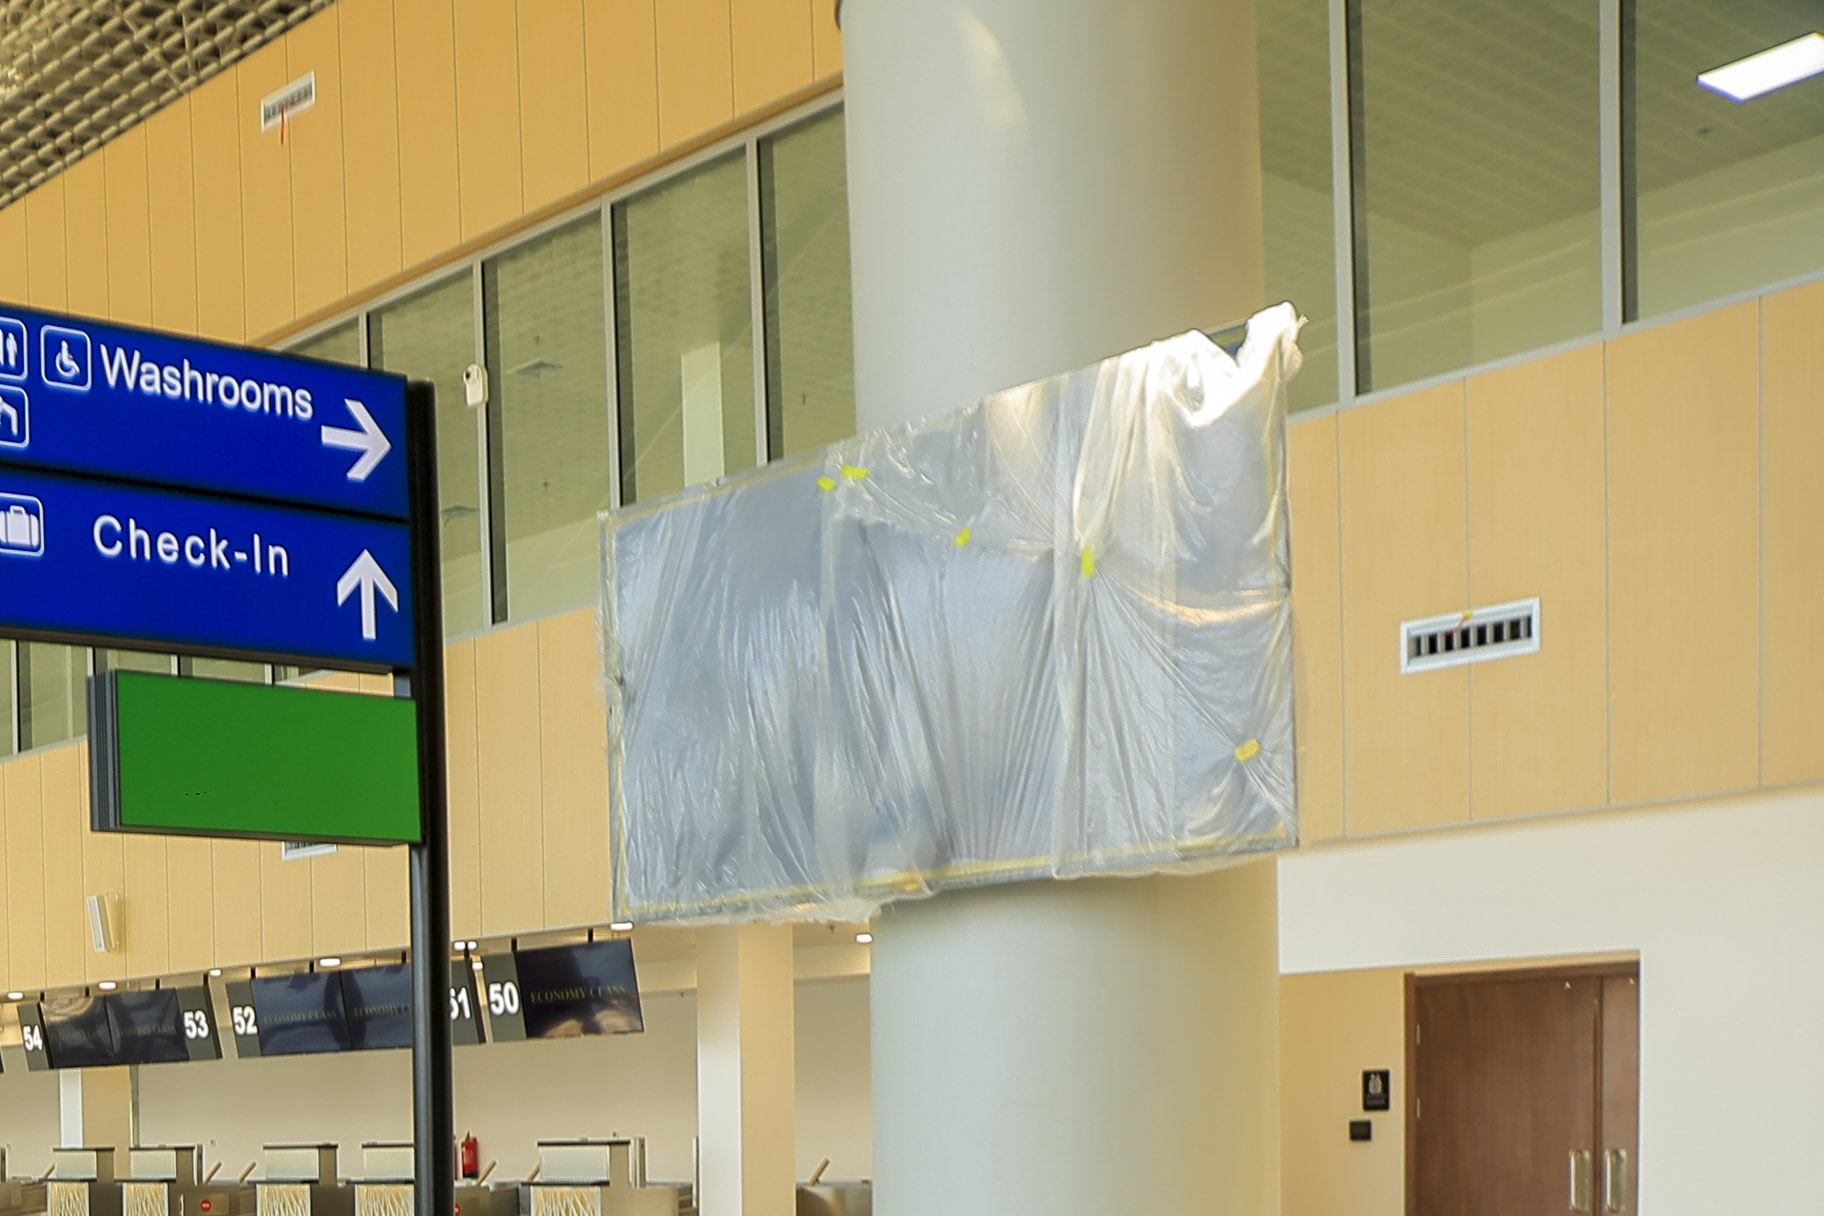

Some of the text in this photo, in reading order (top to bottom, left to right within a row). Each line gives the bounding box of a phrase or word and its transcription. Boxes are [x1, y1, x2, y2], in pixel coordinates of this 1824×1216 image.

[99, 343, 314, 420] Washrooms
[92, 514, 289, 578] Check-In
[488, 981, 520, 1016] 50
[183, 1009, 210, 1040] 53
[232, 1005, 259, 1036] 52
[22, 1024, 44, 1052] 54
